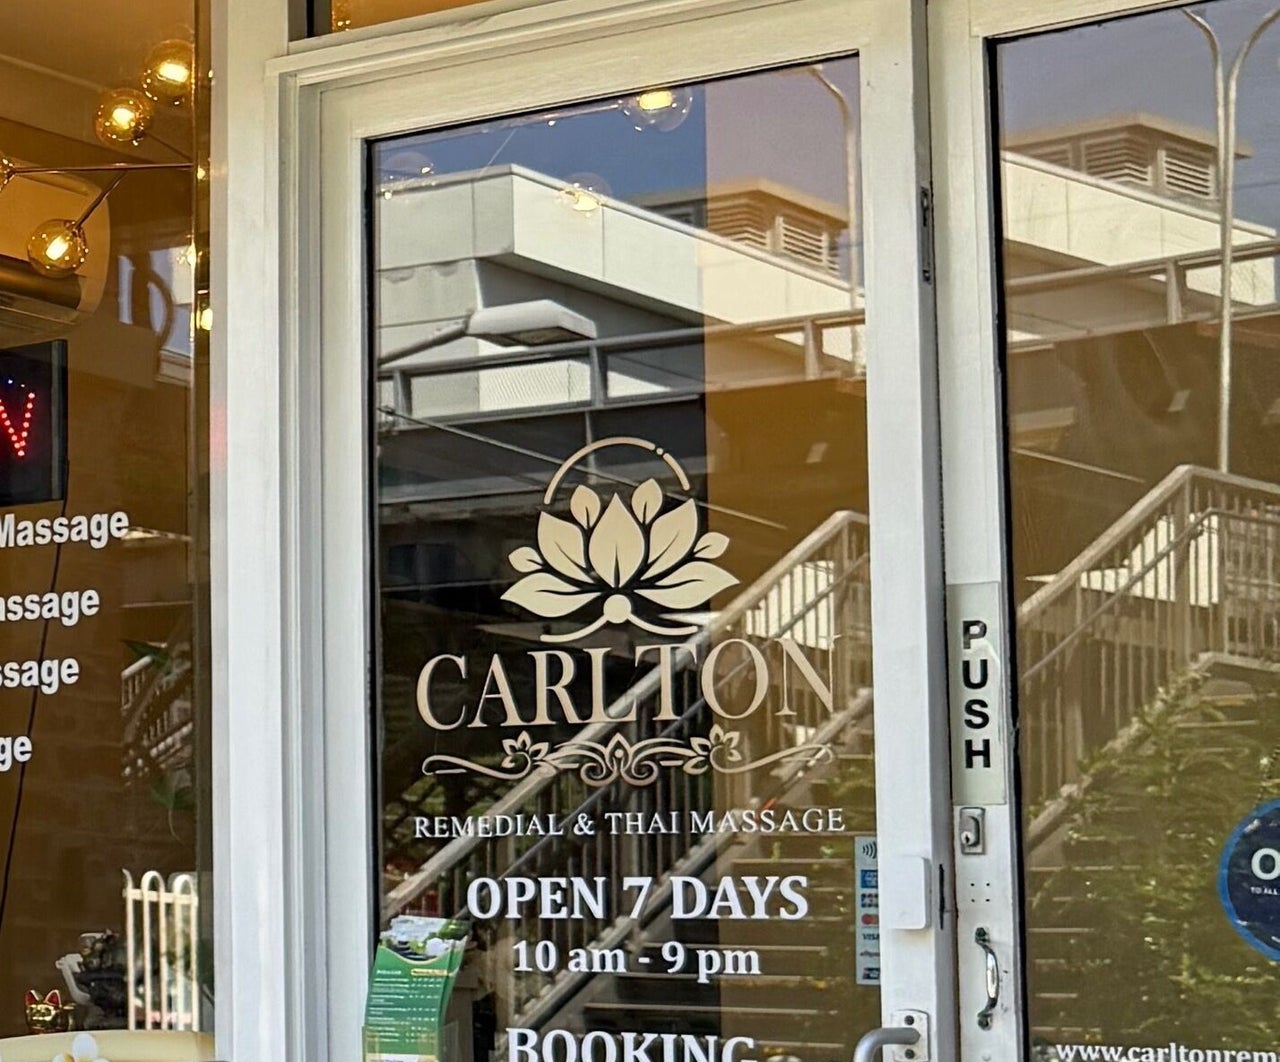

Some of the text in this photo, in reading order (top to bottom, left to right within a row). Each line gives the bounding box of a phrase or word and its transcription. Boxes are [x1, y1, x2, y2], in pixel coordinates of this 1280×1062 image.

[416, 635, 842, 730] CARLTON
[961, 619, 992, 769] PUSH
[414, 807, 846, 840] REMEDIAL & THAI MASSAGE
[467, 876, 605, 921] OPEN
[623, 876, 650, 920] 7
[670, 875, 808, 920] DAYS
[514, 941, 558, 973] 10
[568, 947, 632, 974] am
[661, 941, 685, 974] 9
[697, 947, 762, 983] pm
